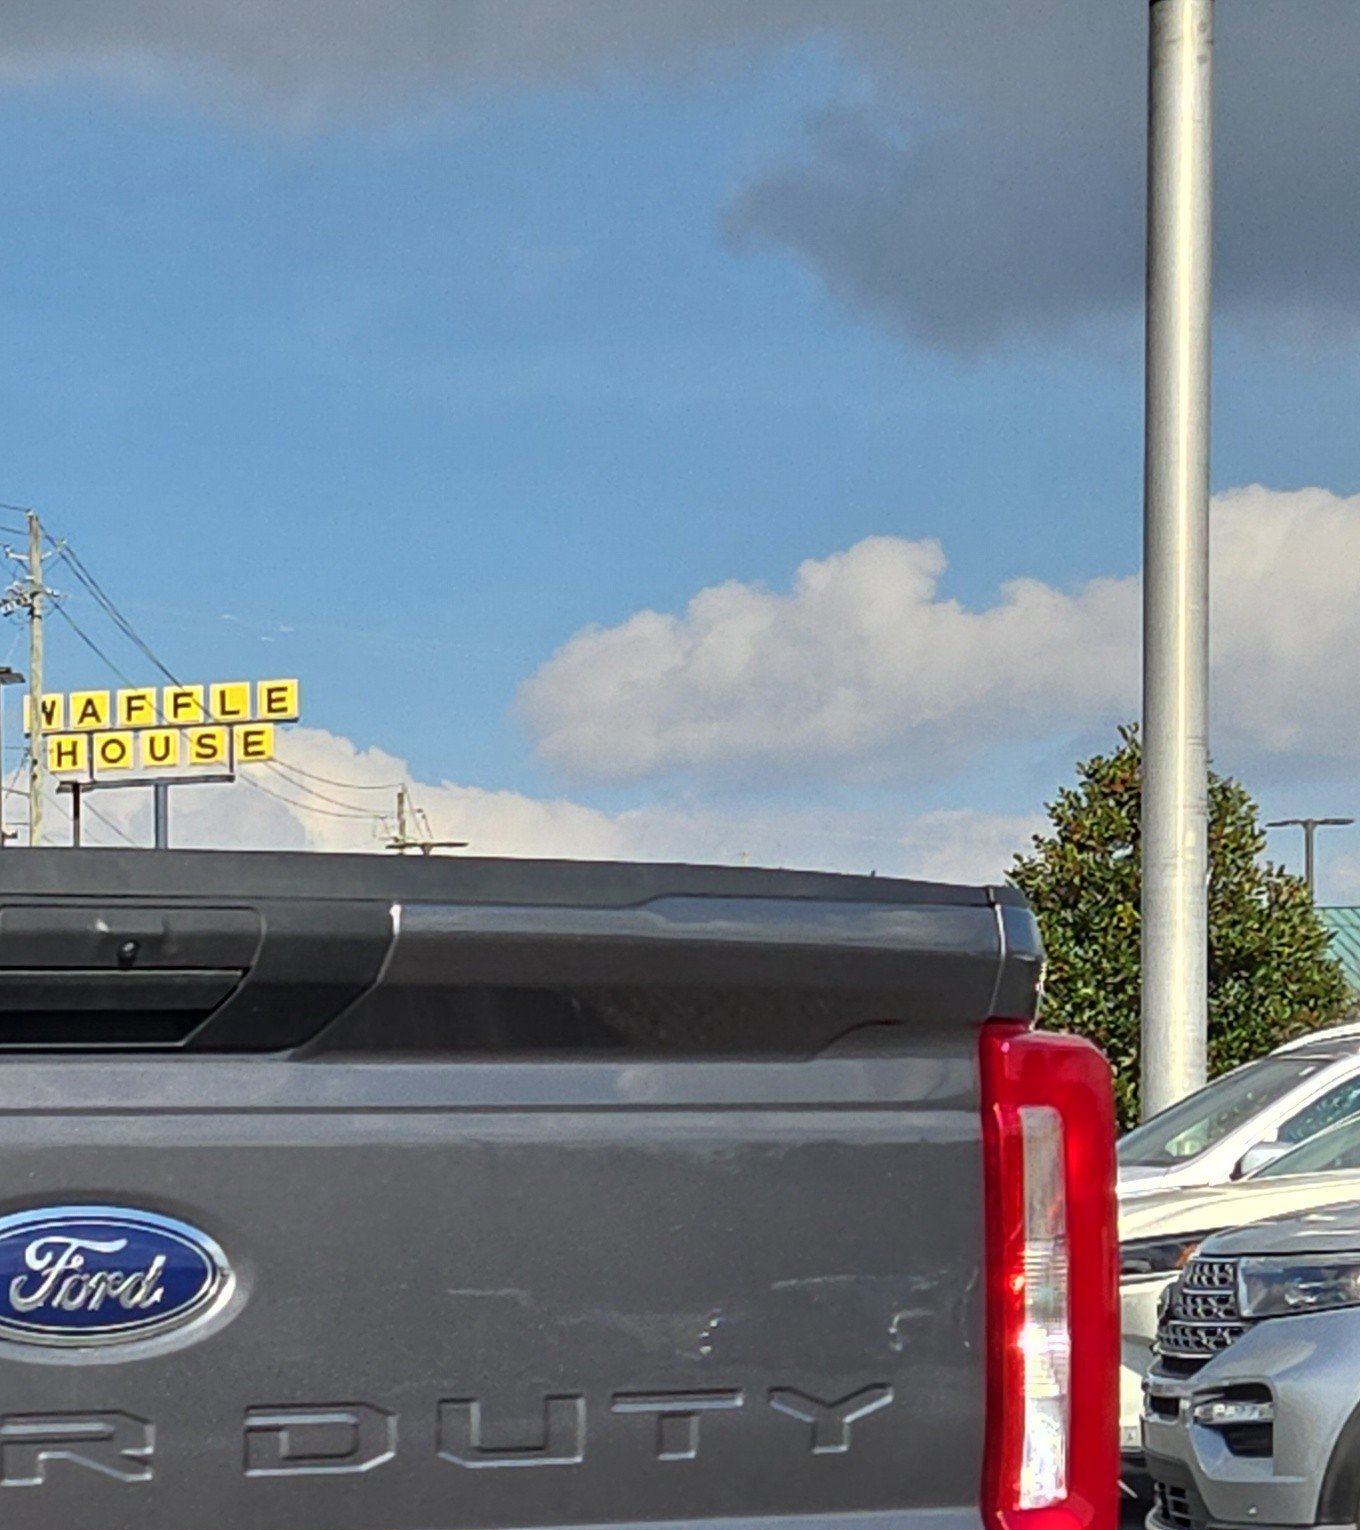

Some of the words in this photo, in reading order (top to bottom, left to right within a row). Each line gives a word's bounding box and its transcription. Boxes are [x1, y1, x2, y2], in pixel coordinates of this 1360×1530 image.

[56, 730, 266, 768] HOUSE
[9, 1236, 166, 1312] Ford
[244, 1383, 894, 1477] DUTY
